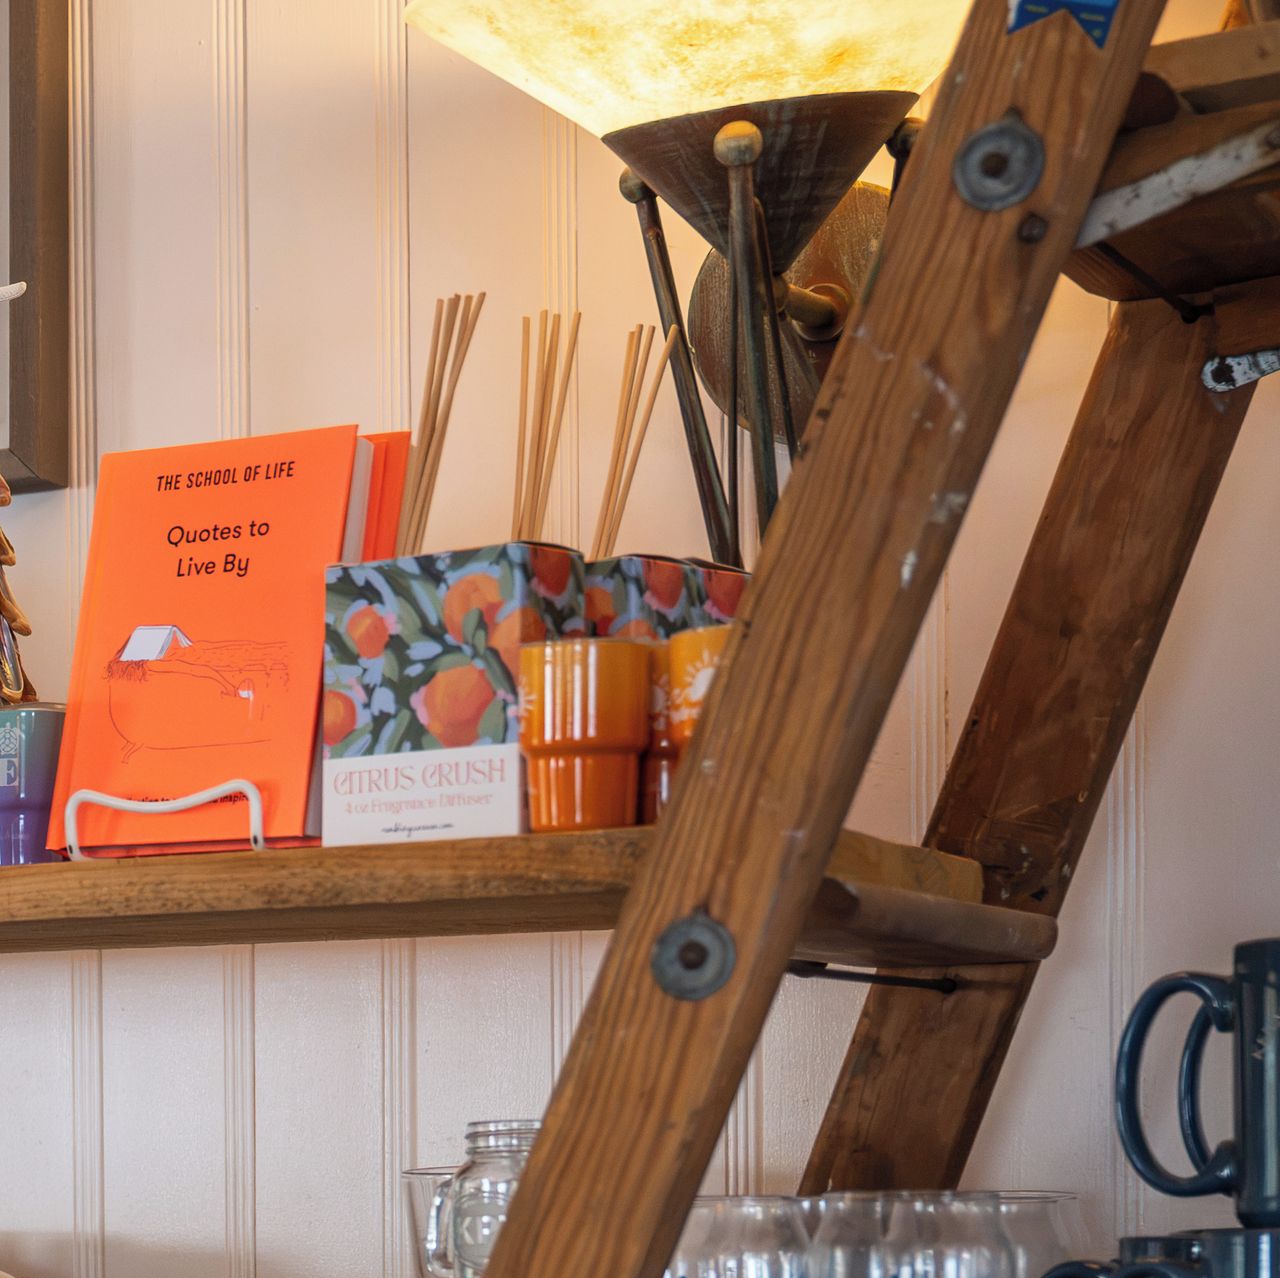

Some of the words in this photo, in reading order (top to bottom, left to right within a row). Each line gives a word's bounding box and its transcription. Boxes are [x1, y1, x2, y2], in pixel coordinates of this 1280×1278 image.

[157, 474, 182, 492] THE
[186, 467, 238, 488] SCHOOL
[244, 465, 261, 482] OF
[265, 461, 295, 480] LIFE
[167, 524, 242, 548] Quotes
[249, 520, 270, 536] to
[176, 557, 216, 577] Live
[223, 553, 250, 577] By
[333, 765, 416, 796] CITRUS
[421, 757, 506, 789] CRUSH
